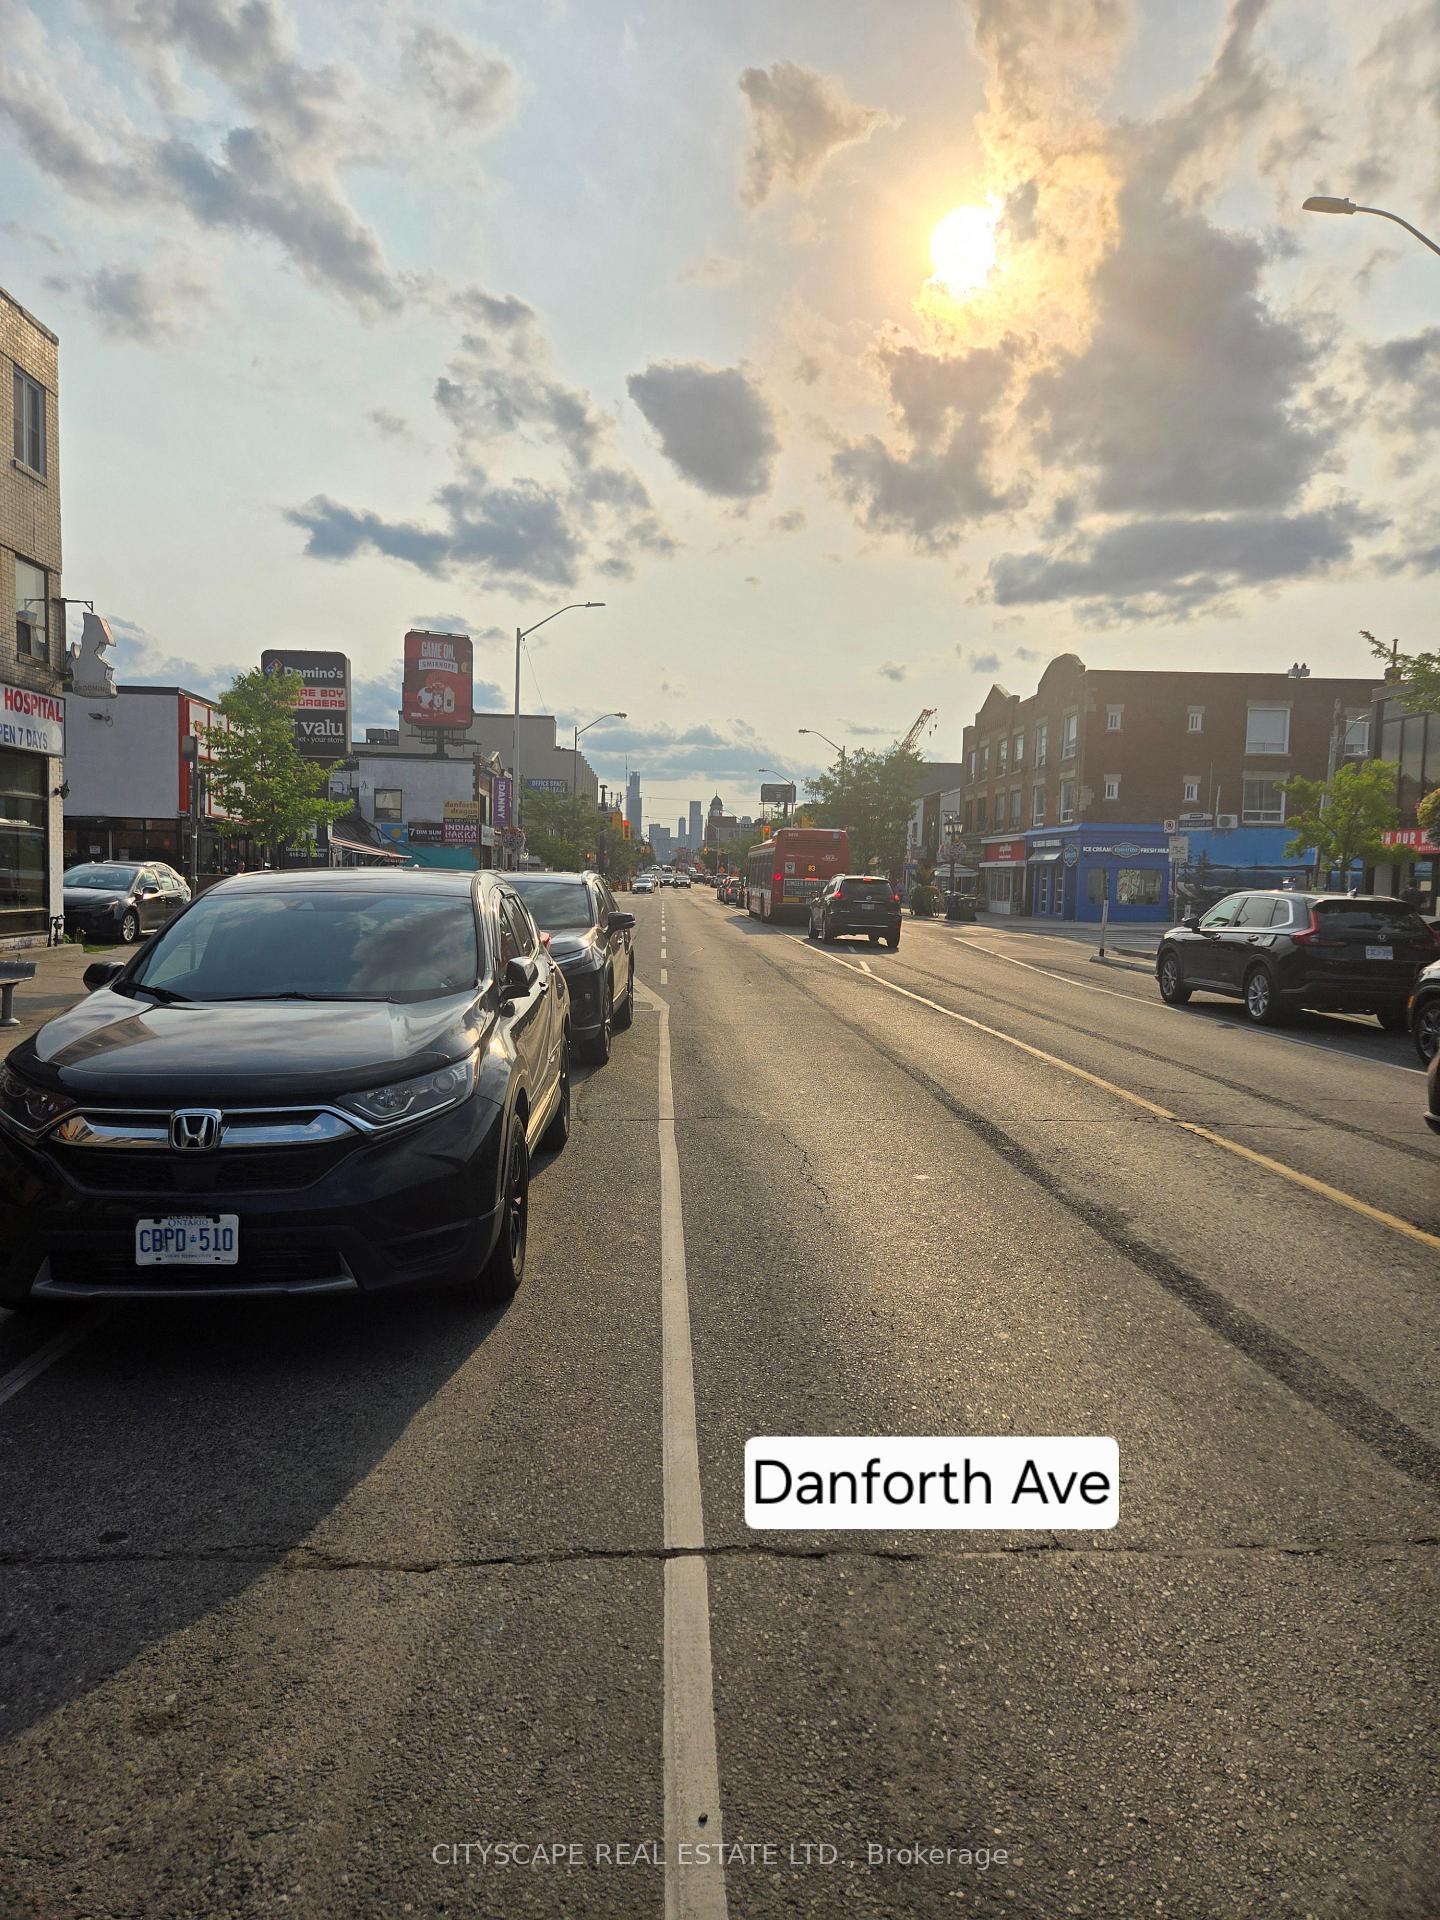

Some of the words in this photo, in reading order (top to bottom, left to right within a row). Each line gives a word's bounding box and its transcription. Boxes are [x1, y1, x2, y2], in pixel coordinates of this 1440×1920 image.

[422, 641, 442, 659] GAME
[284, 666, 344, 679] Domino's
[320, 690, 344, 698] BOY
[4, 687, 64, 722] HOSPITAL
[301, 719, 345, 736] valu
[18, 727, 24, 745] 7
[26, 729, 48, 750] DAYS
[532, 780, 550, 788] OFFICE
[497, 785, 506, 818] DANNY
[408, 828, 416, 837] 7
[1396, 831, 1416, 845] OUR
[807, 864, 816, 872] 83
[168, 1218, 209, 1227] ONTARIO
